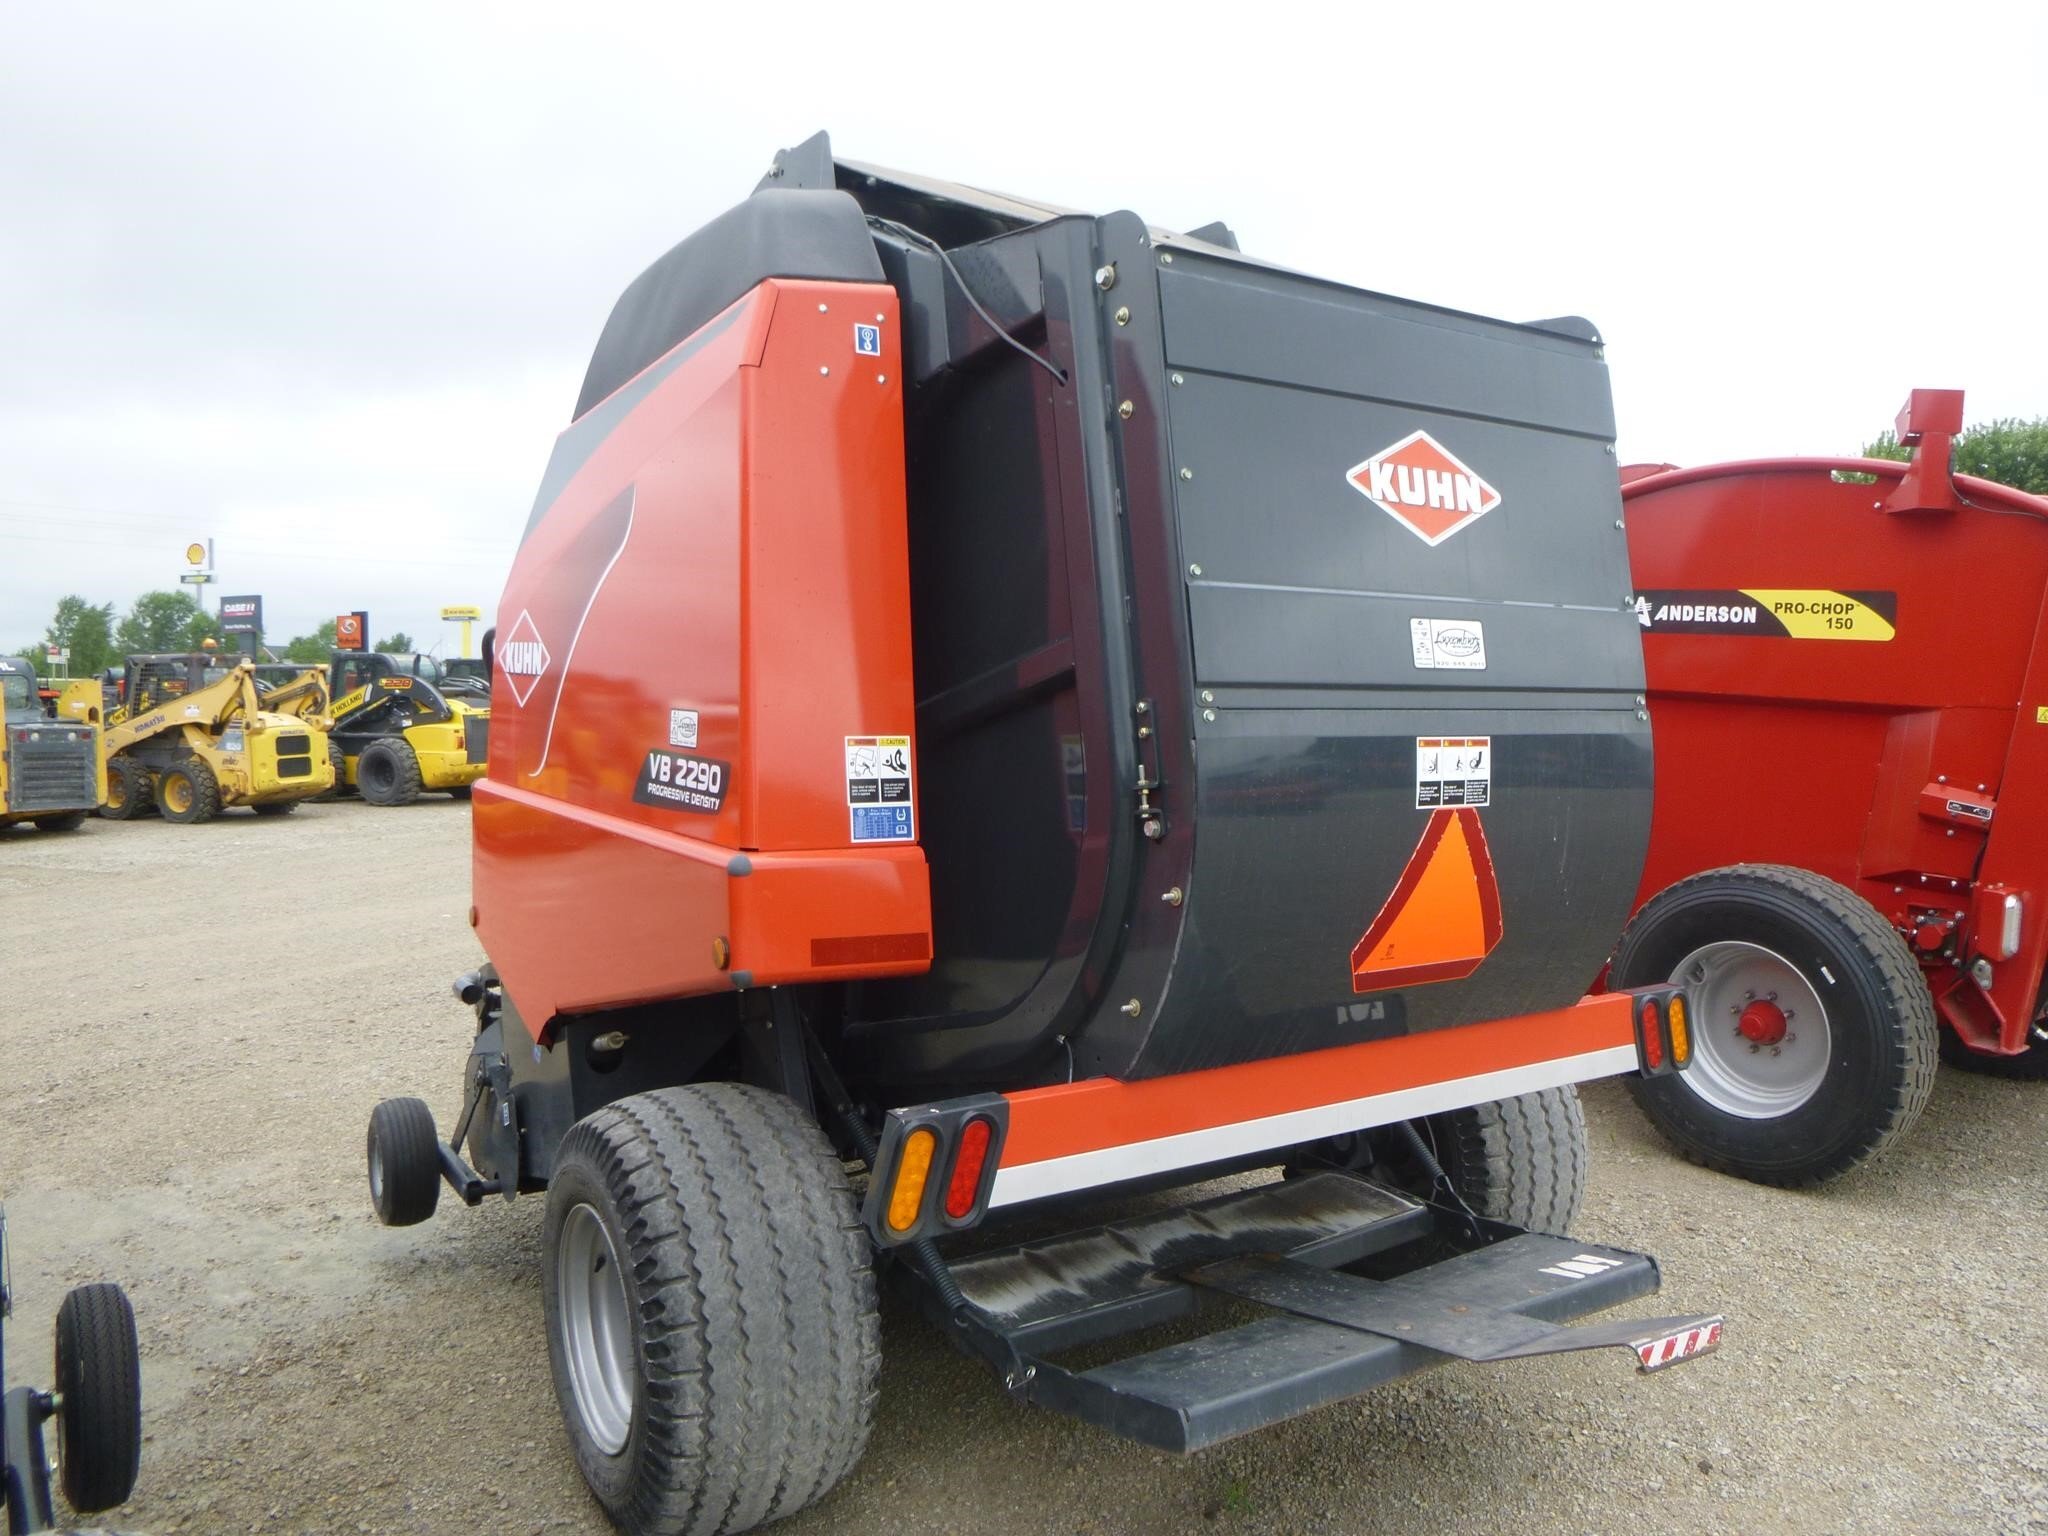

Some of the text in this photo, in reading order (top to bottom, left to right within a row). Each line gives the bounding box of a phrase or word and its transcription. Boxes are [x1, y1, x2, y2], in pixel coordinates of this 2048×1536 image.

[1368, 461, 1483, 514] KUHN
[1654, 604, 1756, 624] ANDERSON
[1774, 602, 1855, 615] PRO-CHOP
[1825, 617, 1854, 630] 150
[505, 642, 543, 675] KUHN
[134, 714, 167, 734] KOMATSU
[650, 753, 721, 793] VB 2290
[647, 783, 720, 810] PROGRESSIVE DENSITY
